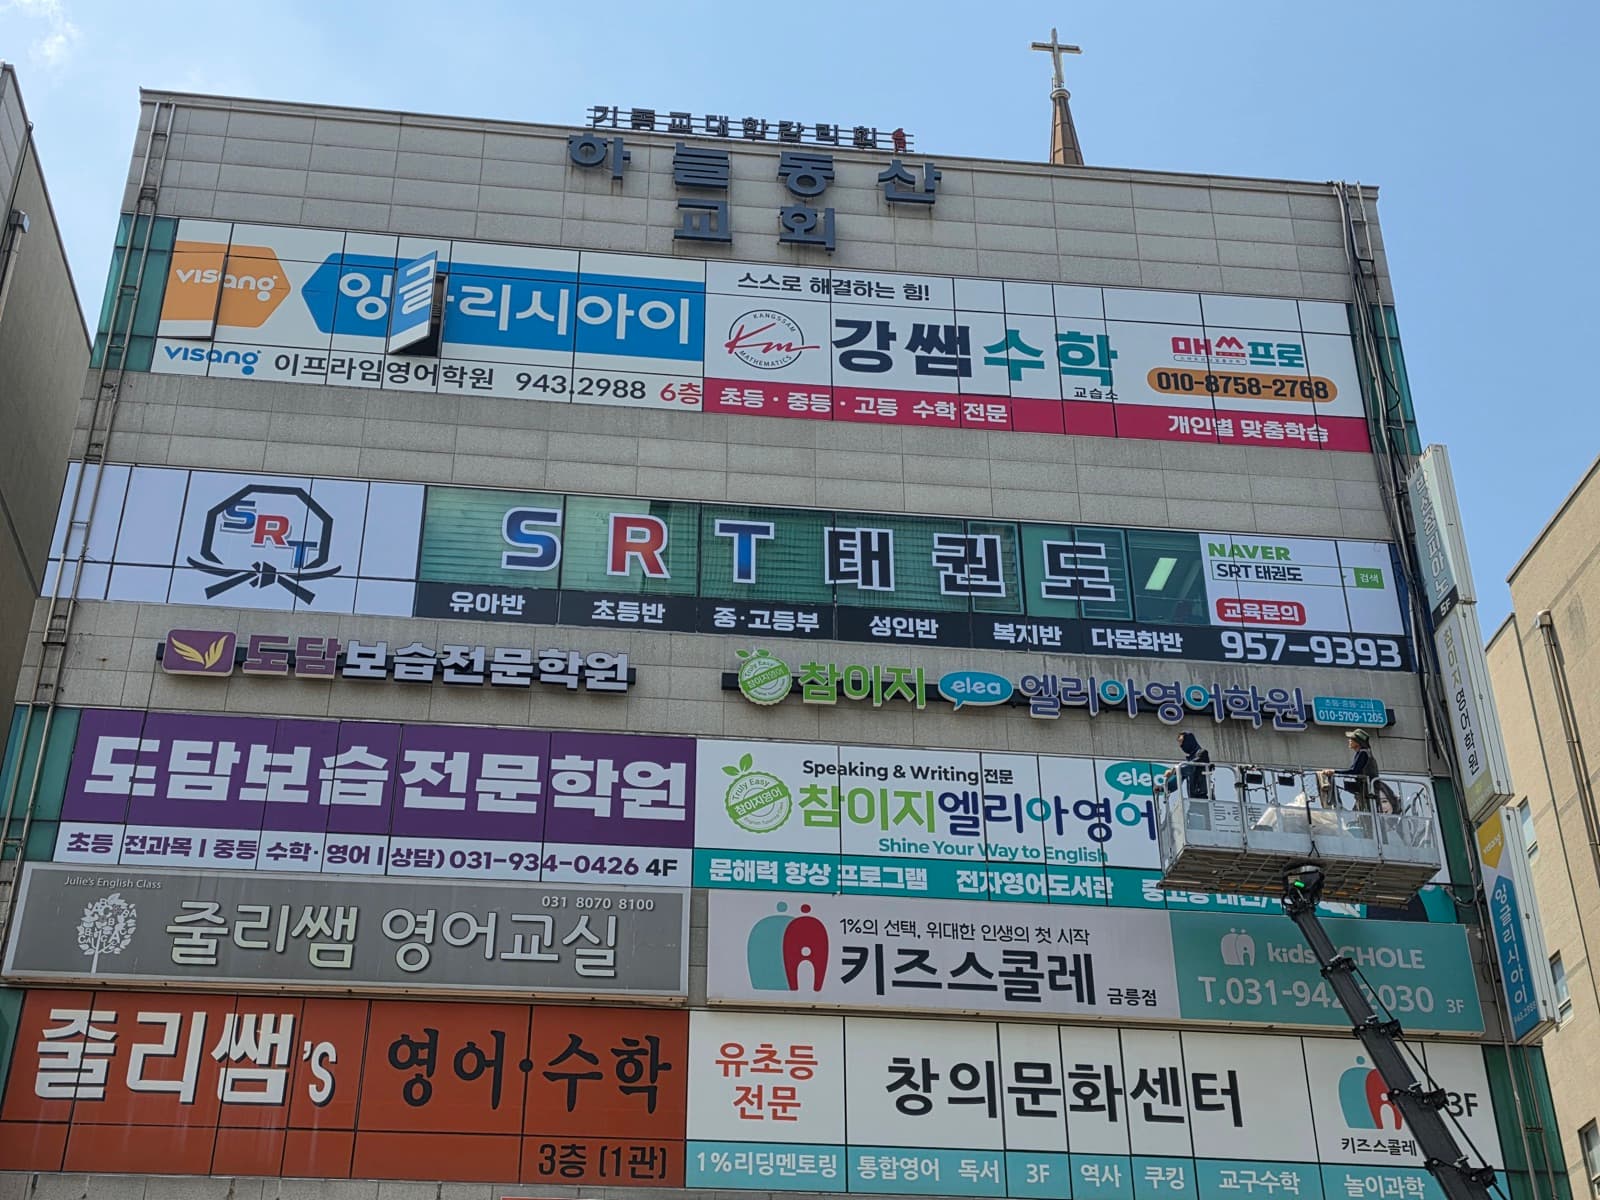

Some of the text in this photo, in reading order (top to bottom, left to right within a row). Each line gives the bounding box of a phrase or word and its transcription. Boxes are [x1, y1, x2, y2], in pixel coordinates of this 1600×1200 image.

[672, 198, 836, 252] 교회
[175, 267, 277, 301] visang
[737, 272, 931, 302] 스스로 해결하는 힘!
[163, 344, 263, 376] visang
[739, 350, 793, 367] MATHEMATICS
[275, 353, 704, 408] 이프라임영어학원 943.2988 6층
[1074, 387, 1119, 401] 교습소
[1156, 371, 1330, 400] 010-8758-2768
[719, 386, 1008, 424] 초등 중등 고등 수학 전문
[1168, 415, 1329, 442] 개인별 맞춤학습
[1208, 542, 1292, 561] NAVER
[1216, 562, 1303, 583] SRT 태권도
[1359, 571, 1379, 587] 검색
[1223, 602, 1299, 622] 교육문의
[449, 590, 1402, 668] 유아반 초등반 중·고등부 성인반 복지반 다문화반 957-9393
[799, 660, 926, 710] 참이지
[1019, 673, 1308, 732] 엘리아영어학원
[83, 735, 687, 821] 도담보습전문학원
[802, 759, 1014, 786] Speaking & Writing 전문
[731, 777, 771, 801] Truly Easy
[734, 786, 782, 816] 참이지영어
[66, 832, 114, 854] 초등
[124, 834, 193, 858] 전과목
[213, 838, 258, 860] 중등
[449, 850, 640, 876] 031-934-0426
[645, 858, 678, 877] 4F
[878, 838, 1109, 865] Shine Your Way to English
[64, 875, 162, 890] Julie's English Class
[709, 857, 778, 884] 문해력
[784, 860, 831, 887] 향상
[837, 863, 929, 891] 프로그램
[956, 869, 1114, 900] 전자영어도서관
[541, 895, 654, 912] 031 8070 8100
[166, 900, 358, 969] 줄리쌤
[381, 908, 617, 978] 영어교실
[840, 917, 1090, 946] 1%의 선택, 위대한 인생의 첫 시작
[1494, 884, 1528, 1004] 잉글리시아이
[1328, 944, 1426, 969] CHOLE
[840, 942, 1157, 1007] 키즈스콜레 금릉점
[1446, 998, 1465, 1014] 3F
[715, 1042, 819, 1081] 유초등
[733, 1084, 801, 1122] 전문
[886, 1056, 1243, 1128] 창의문화센터
[538, 1143, 588, 1178] 3층
[1341, 1136, 1418, 1157] 키즈스콜레
[857, 1155, 941, 1181] 통합영어
[958, 1159, 1000, 1184] 독서
[1026, 1163, 1050, 1184] 3F
[1080, 1164, 1122, 1188] 역사
[1144, 1165, 1185, 1190] 쿠킹
[1218, 1169, 1301, 1196] 교구수학
[1343, 1173, 1426, 1200] 놀이과학
